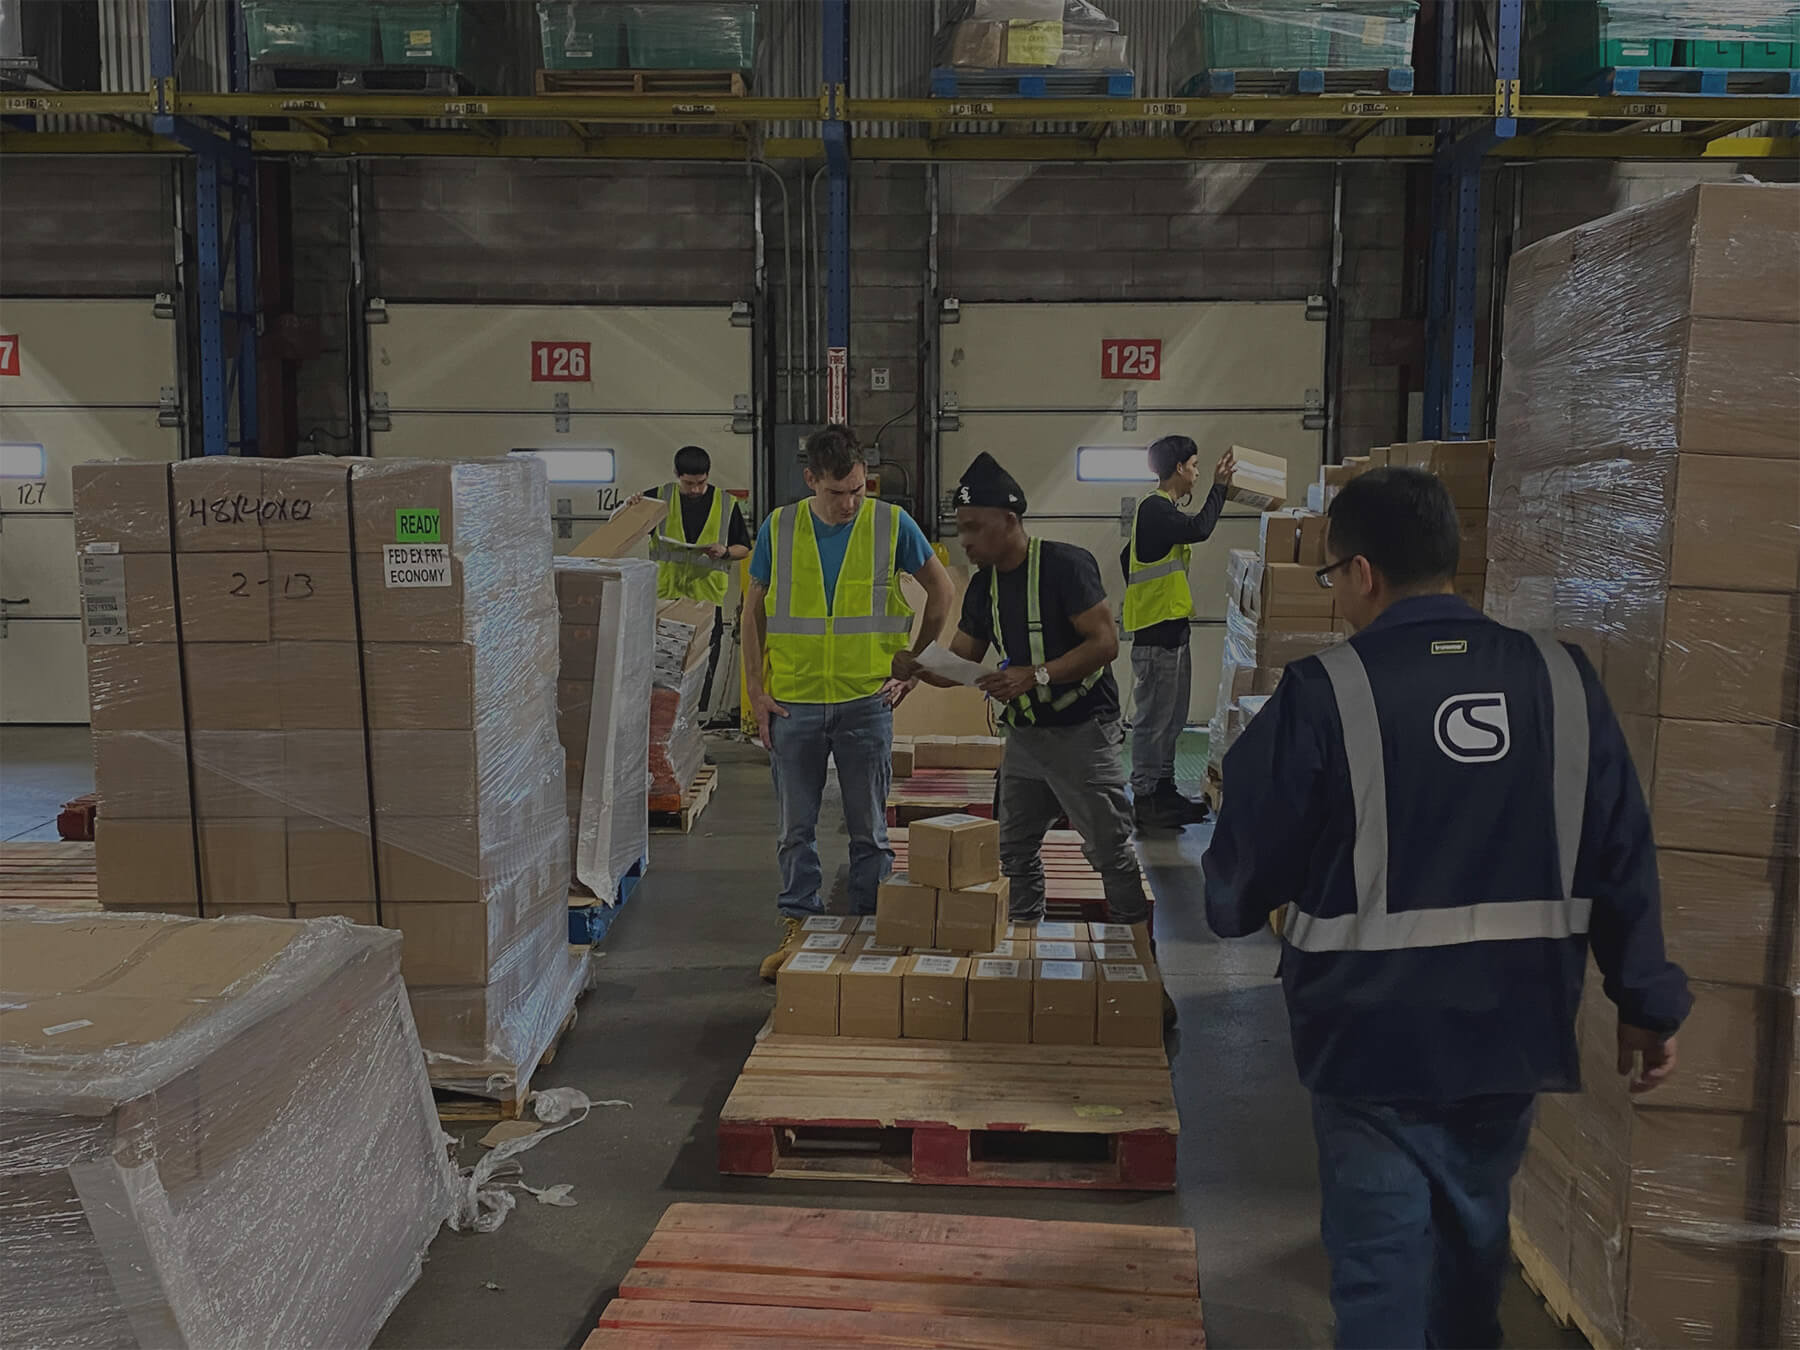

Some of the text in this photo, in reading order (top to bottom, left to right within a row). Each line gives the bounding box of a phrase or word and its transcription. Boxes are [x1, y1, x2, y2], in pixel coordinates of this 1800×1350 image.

[537, 347, 585, 376] 126
[829, 355, 845, 365] FIRE
[1107, 345, 1155, 374] 125
[17, 482, 47, 505] 127
[597, 487, 625, 511] 126
[400, 515, 440, 534] READY
[388, 548, 443, 565] FED EX FRT
[391, 569, 445, 583] ECONOMY
